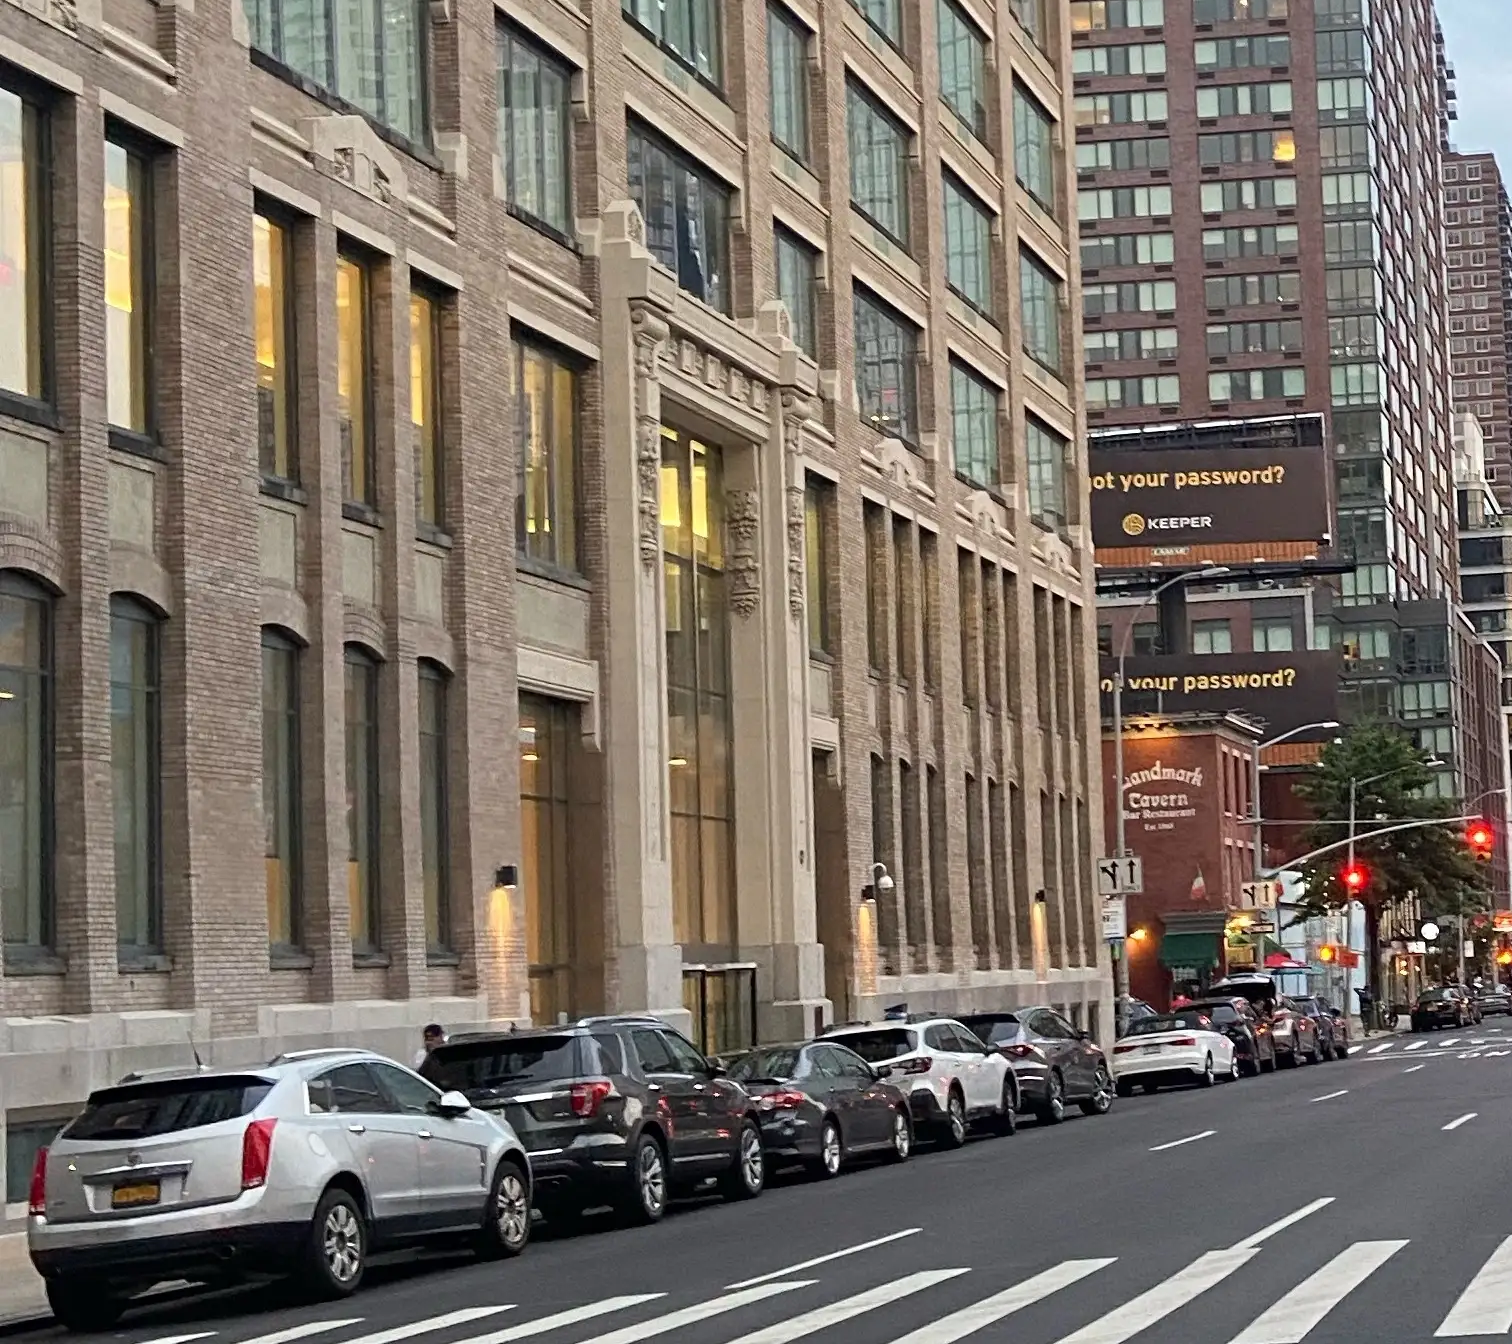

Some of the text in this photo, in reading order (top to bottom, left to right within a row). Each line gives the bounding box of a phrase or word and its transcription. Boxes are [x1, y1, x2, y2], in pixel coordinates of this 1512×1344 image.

[1120, 472, 1170, 492] your
[1174, 465, 1285, 490] password?
[1147, 515, 1213, 530] KEEPER
[1129, 676, 1178, 692] your
[1183, 668, 1296, 694] password?
[1128, 792, 1189, 809] Tavern
[1123, 808, 1196, 820] Bar Restaurant
